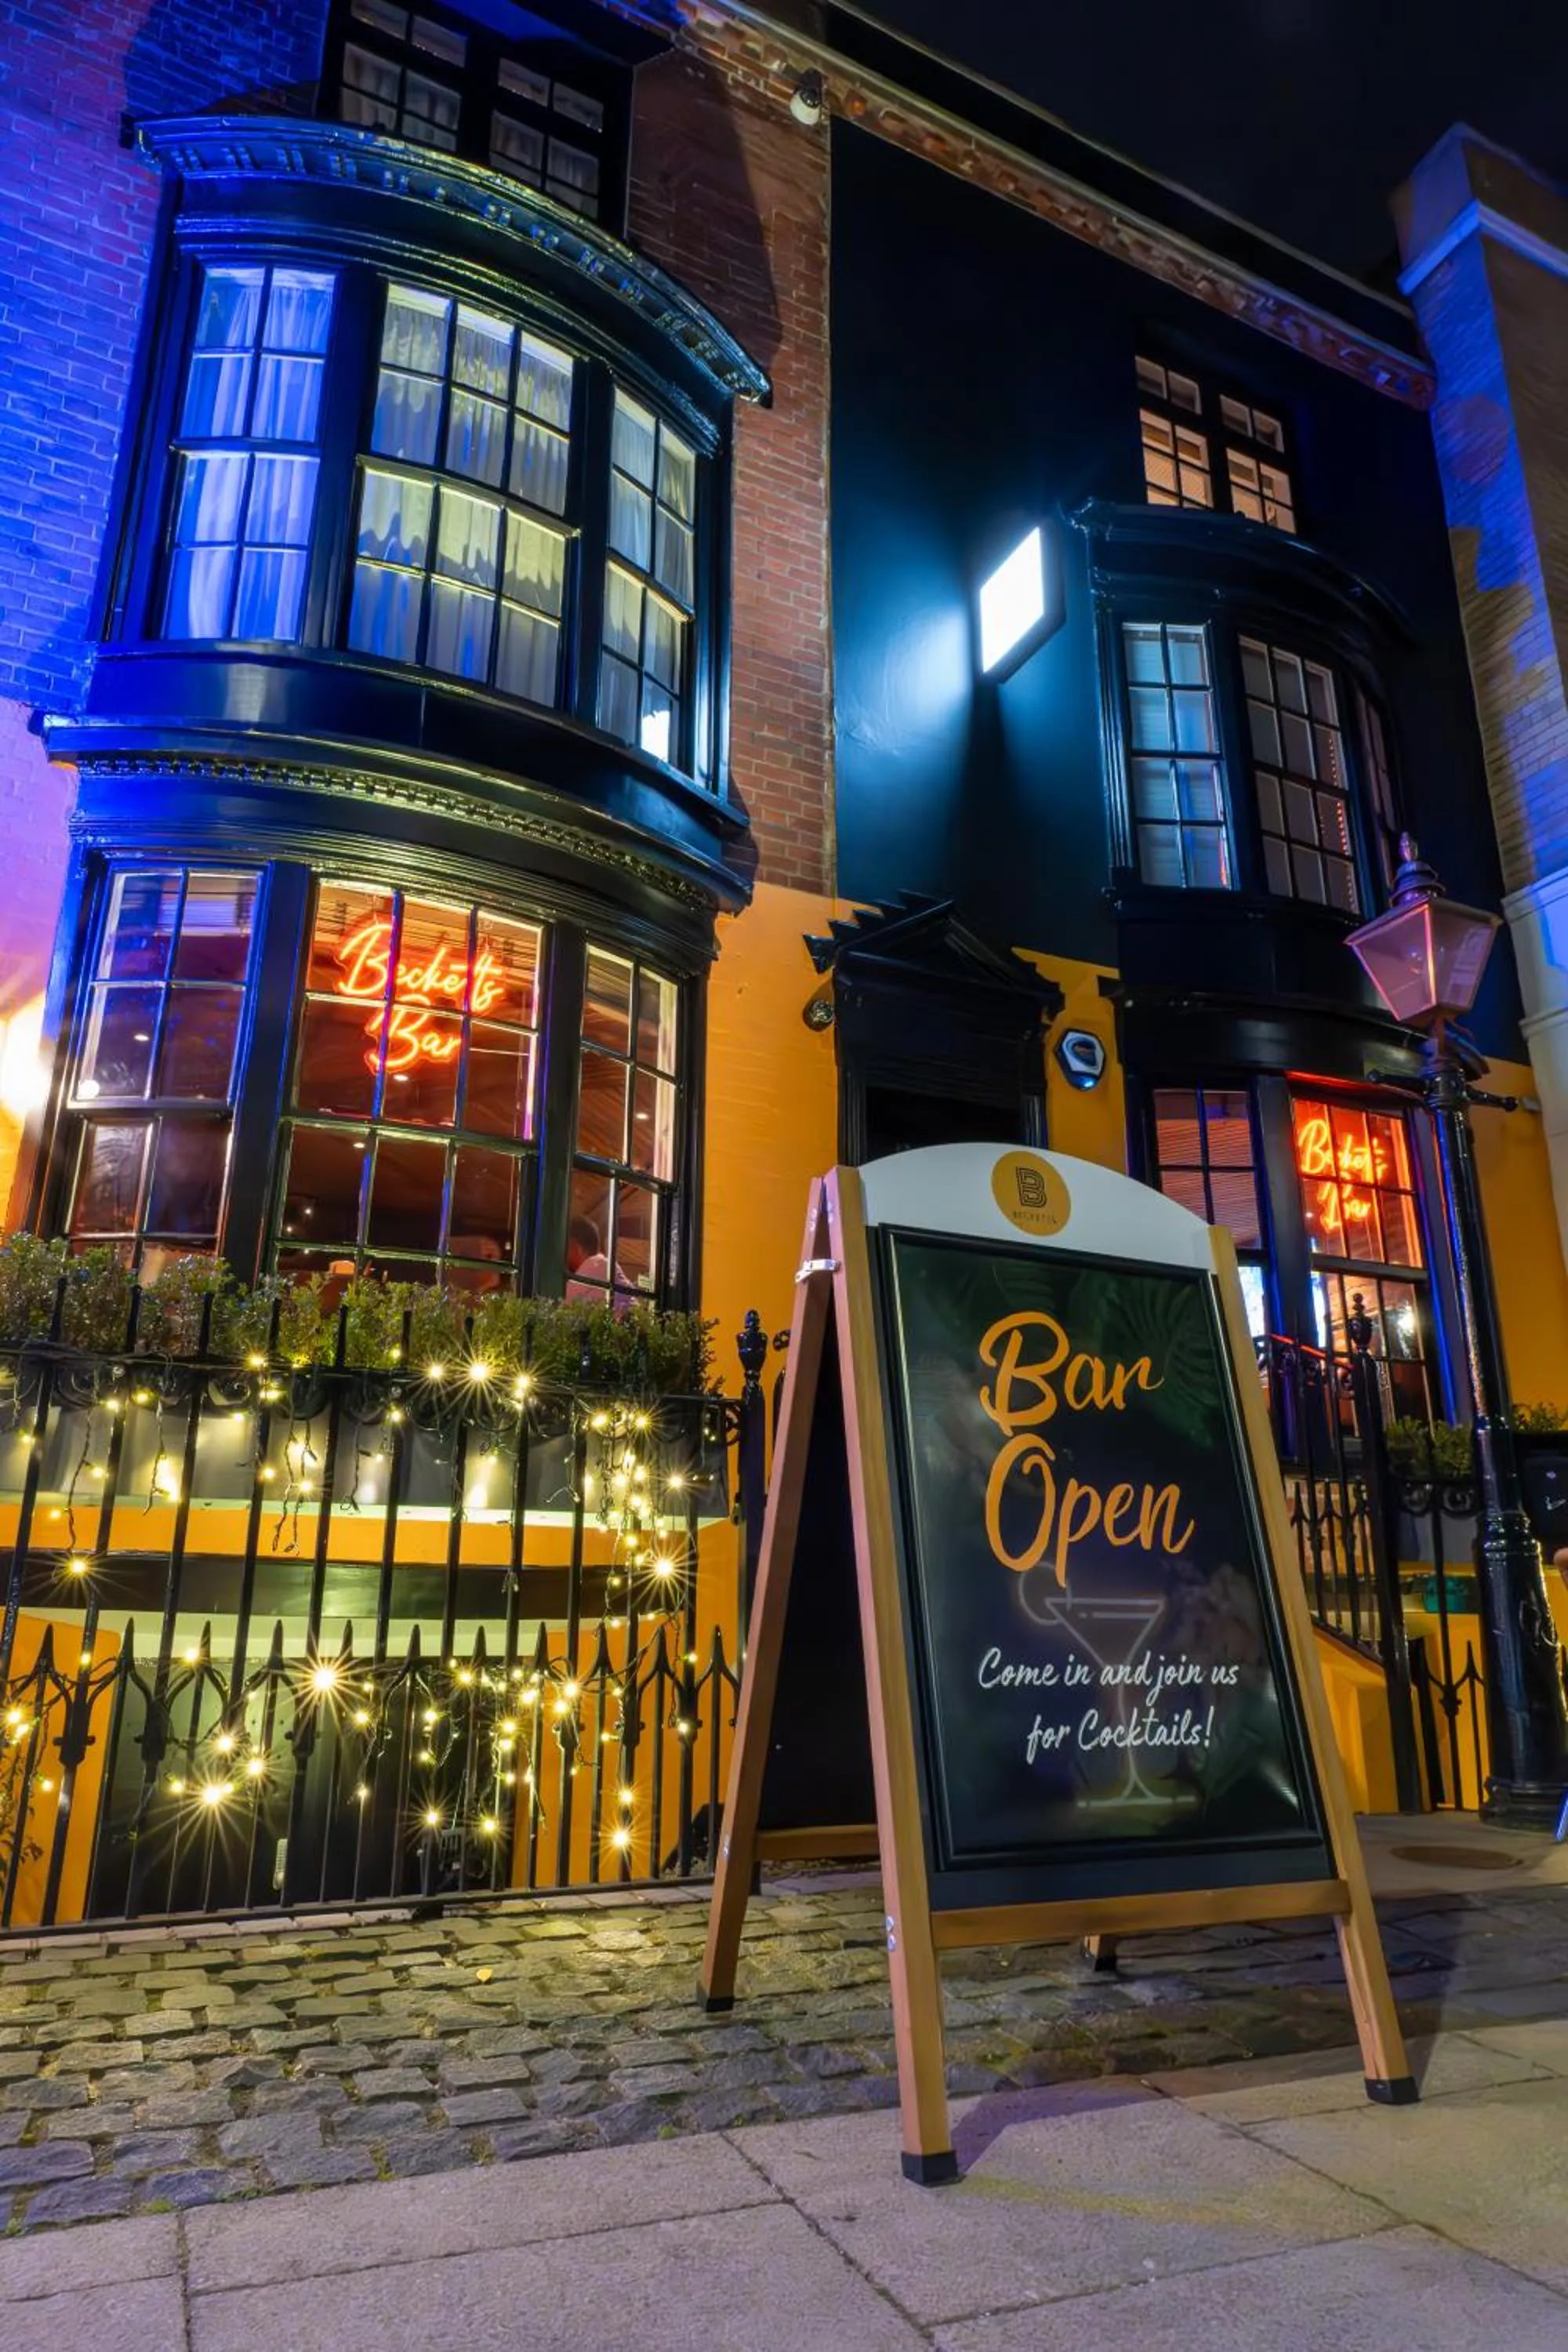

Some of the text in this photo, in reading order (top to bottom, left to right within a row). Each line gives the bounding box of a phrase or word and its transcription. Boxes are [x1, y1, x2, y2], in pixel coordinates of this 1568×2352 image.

[366, 993, 463, 1069] Bar
[978, 1310, 1165, 1437] Bar
[985, 1432, 1196, 1588] Open
[978, 1646, 1240, 1707] Come in and join us
[1026, 1705, 1215, 1765] for Cocktails!
